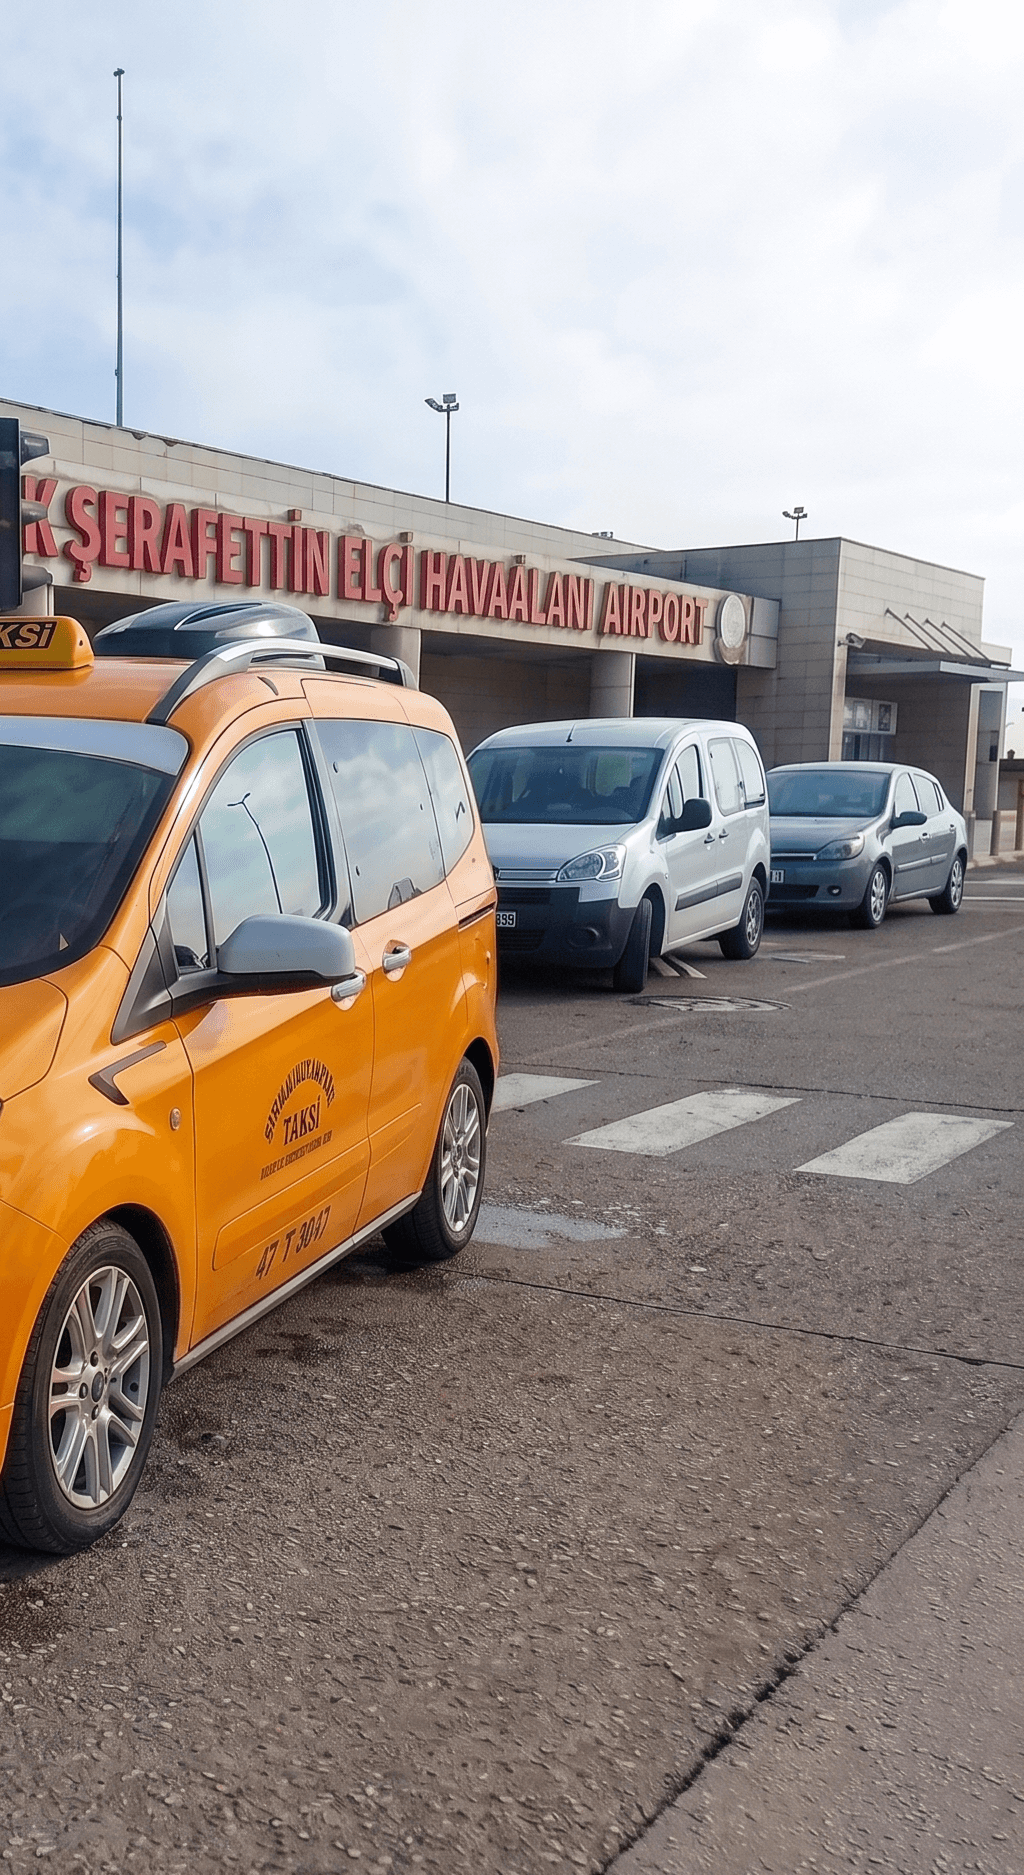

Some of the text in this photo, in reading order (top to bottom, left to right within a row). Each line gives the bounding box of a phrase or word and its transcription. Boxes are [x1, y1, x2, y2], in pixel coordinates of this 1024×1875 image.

[63, 485, 330, 596] ŞERAFETTİN
[338, 531, 414, 622] ELÇİ
[597, 582, 709, 646] AIRPORT
[255, 1239, 280, 1280] 47
[281, 1227, 297, 1263] T
